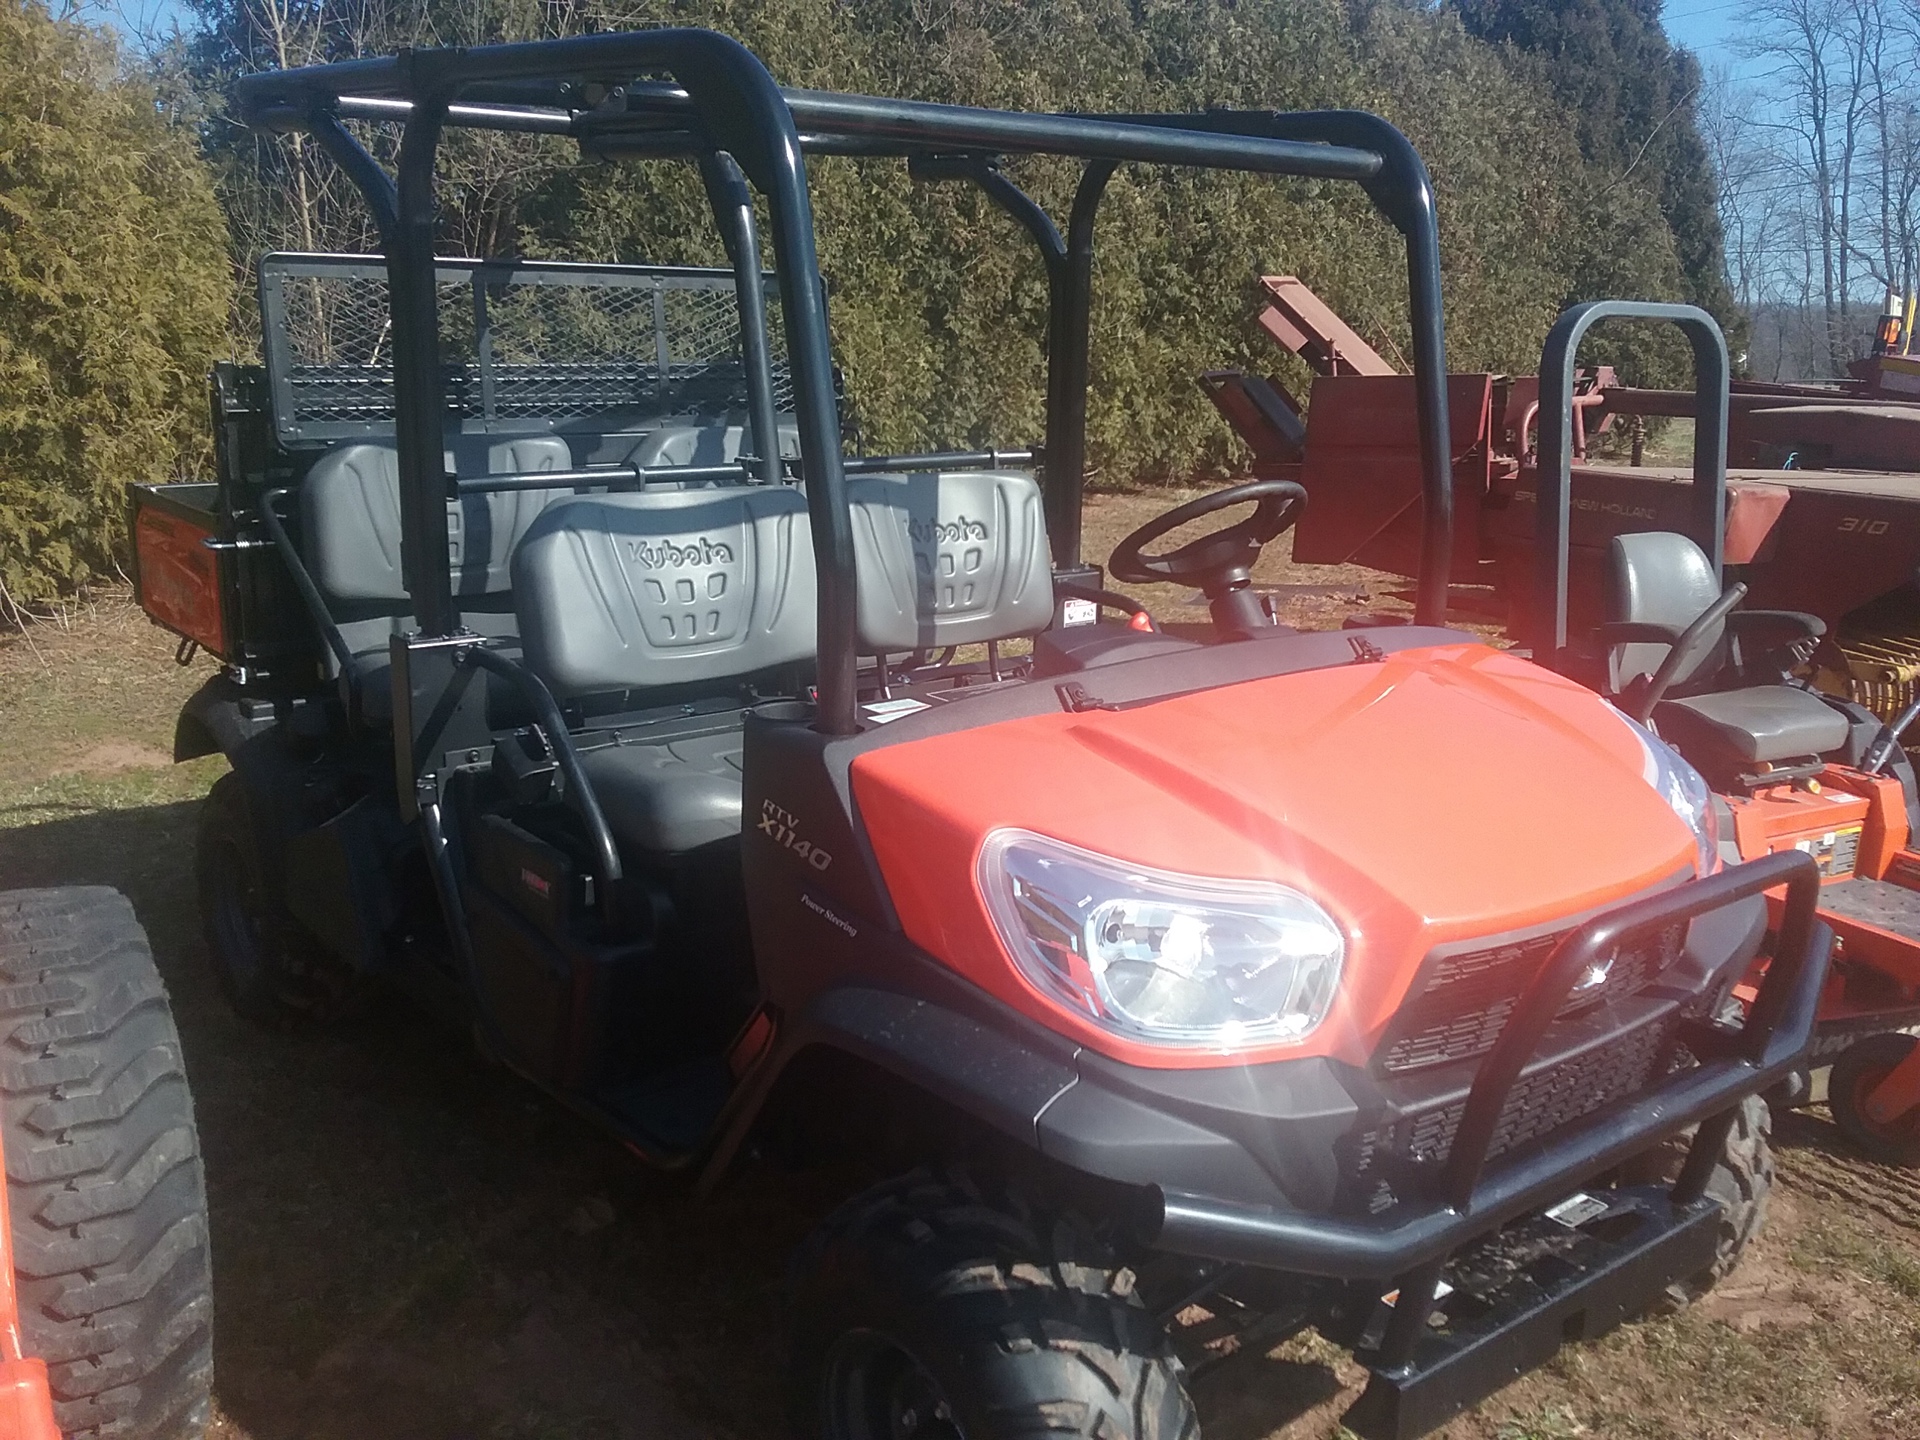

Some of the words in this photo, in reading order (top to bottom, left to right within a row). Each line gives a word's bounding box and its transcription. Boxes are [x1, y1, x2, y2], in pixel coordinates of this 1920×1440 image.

[1600, 501, 1657, 520] HOLLAND
[1837, 516, 1890, 535] 310
[902, 514, 988, 545] Kubota
[627, 536, 735, 570] Kubota
[762, 798, 800, 828] RTV
[757, 812, 833, 871] X1140
[800, 893, 825, 915] Power
[824, 908, 858, 938] Steering
